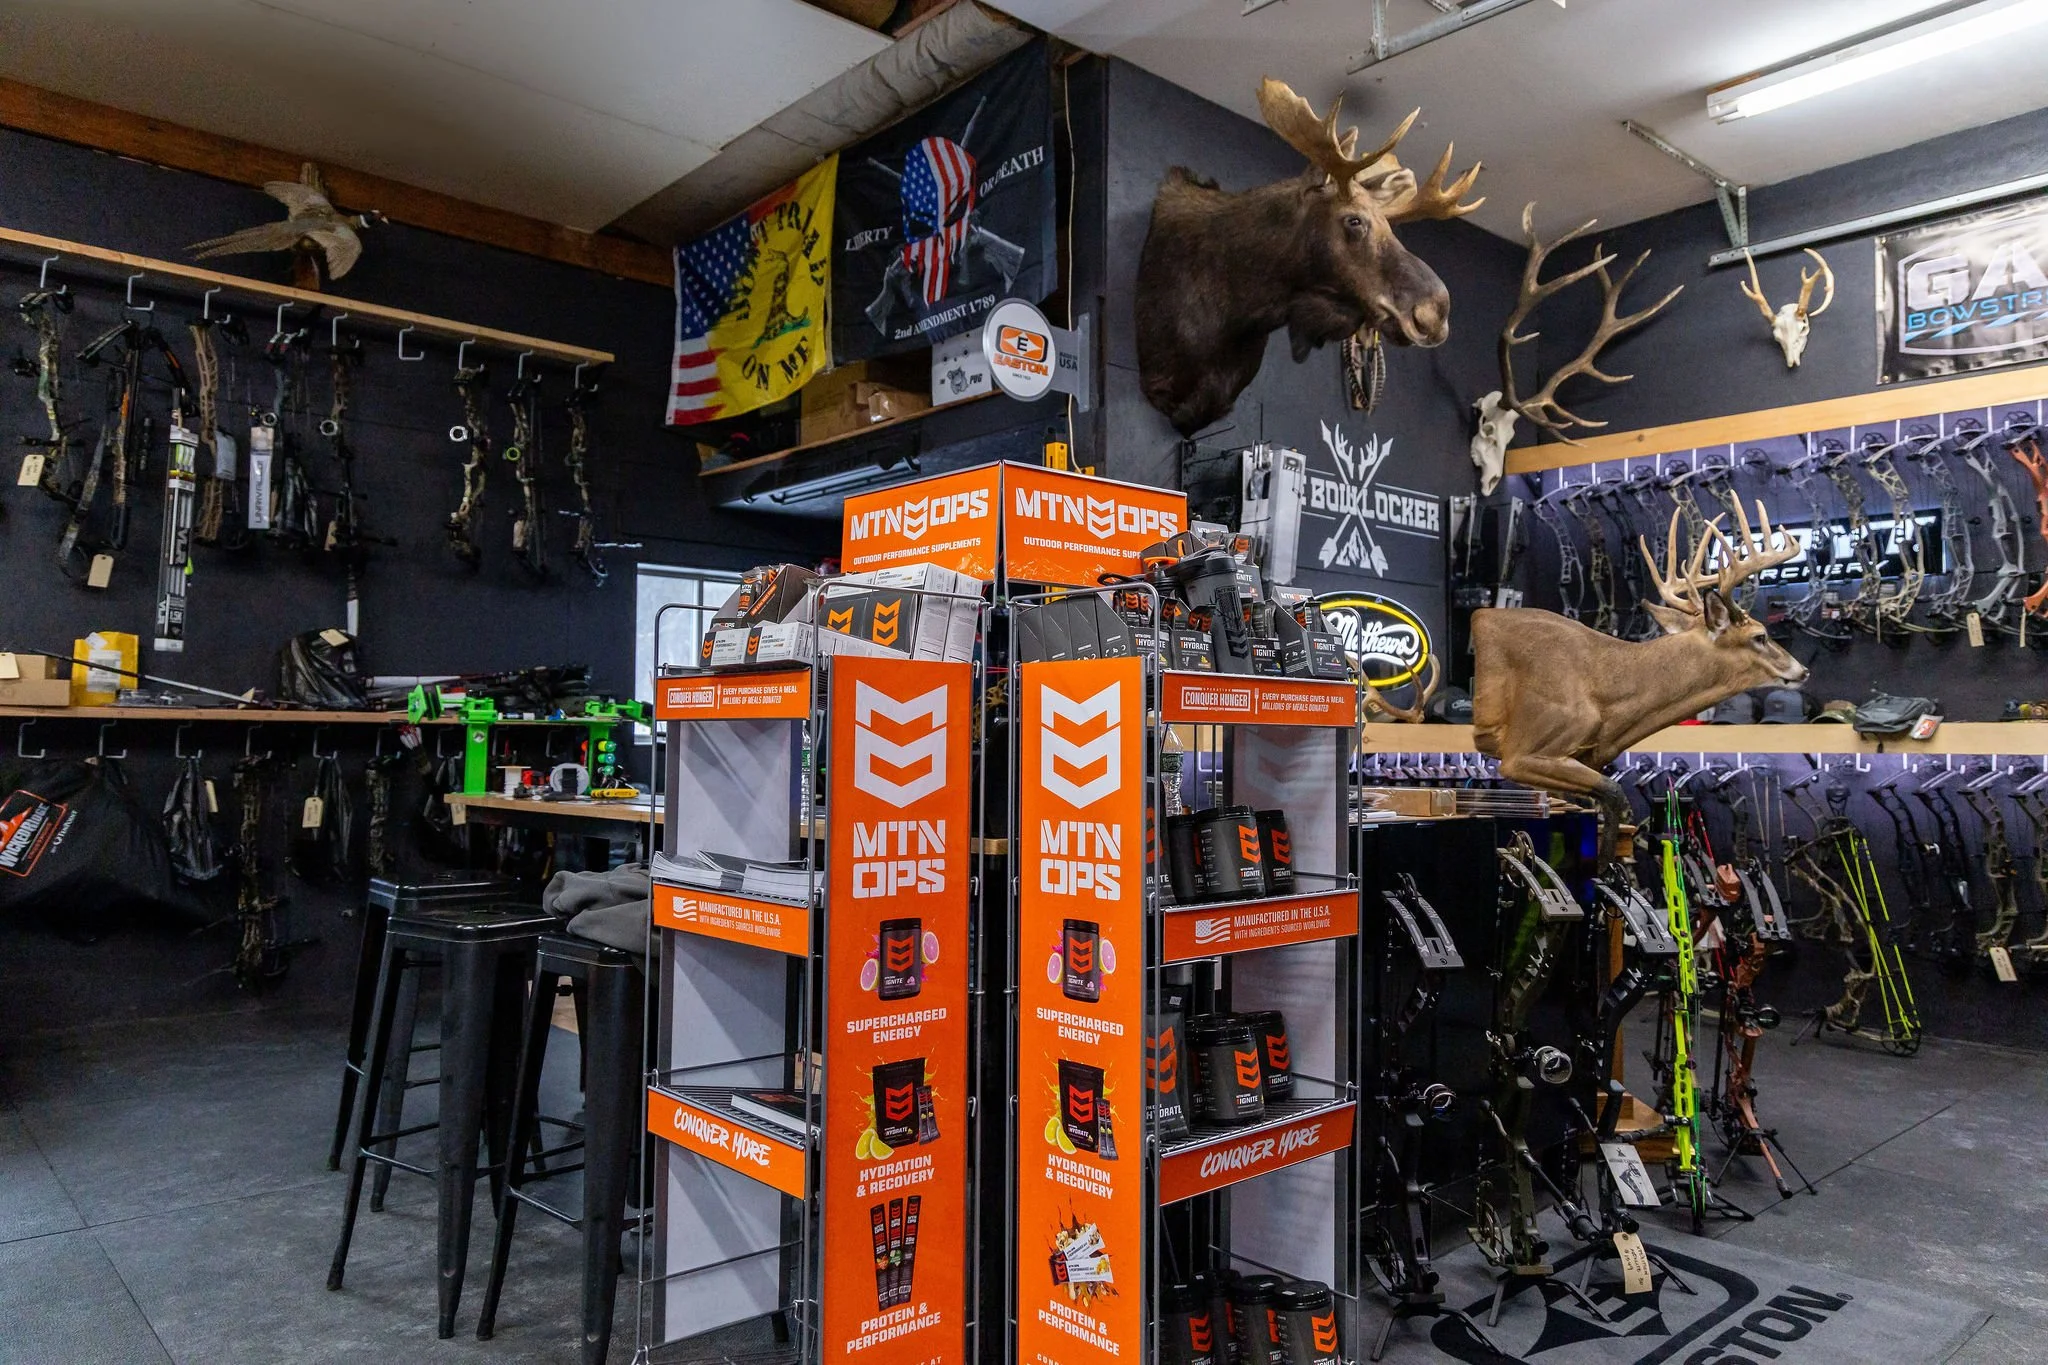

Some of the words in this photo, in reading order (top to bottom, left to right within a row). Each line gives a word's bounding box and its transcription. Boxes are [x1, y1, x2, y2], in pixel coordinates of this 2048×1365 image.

[894, 322, 913, 340] 2nd
[912, 303, 967, 337] AMENDMENT
[968, 294, 996, 316] 1789
[742, 353, 770, 391] ON
[993, 353, 1049, 376] EASTON
[1059, 359, 1078, 371] USA
[970, 373, 982, 384] PUG
[851, 506, 902, 541] MTN
[930, 488, 989, 526] OPS
[1015, 487, 1084, 526] MTN
[1118, 505, 1178, 539] OPS
[1310, 477, 1358, 516] BOW
[1361, 487, 1440, 532] LOCKER
[853, 553, 882, 566] OUTDOOR
[883, 546, 930, 561] PERFORMANCE
[930, 537, 981, 554] SUPPLEMENTS
[1023, 535, 1063, 550] OUTDOOR
[1063, 541, 1121, 558] PERFORMANCE
[1183, 641, 1209, 651] HYDRATE
[1317, 642, 1336, 652] IGNITE
[669, 692, 691, 704] CONQUER
[692, 691, 713, 704] HUNGER
[722, 696, 741, 705] MILLIONS
[748, 696, 762, 704] MEALS
[723, 687, 737, 696] EVERY
[738, 686, 763, 695] PURCHASE
[763, 686, 778, 694] GIVES
[784, 685, 797, 693] MEAL
[1185, 691, 1219, 706] CONQUER
[1219, 693, 1248, 707] HUNGER
[1262, 692, 1280, 701] EVERY
[1281, 693, 1308, 702] PURCHASE
[1309, 695, 1325, 703] GIVES
[1330, 696, 1345, 704] MEAL
[1262, 702, 1285, 711] MILLIONS
[1285, 703, 1292, 711] OF
[1292, 703, 1308, 711] MEALS
[1308, 704, 1329, 712] DONATED
[853, 820, 946, 858] MTN
[1040, 819, 1121, 860] MTN
[852, 859, 945, 899] OPS
[1040, 858, 1121, 901] OPS
[1244, 869, 1261, 877] IGNITE
[1275, 869, 1291, 877] IGNITE
[699, 900, 743, 919] MANUFACTURED
[744, 908, 750, 920] IN
[752, 909, 763, 922] THE
[1234, 910, 1289, 928] MANUFACTURED
[1291, 909, 1298, 920] IN
[1300, 907, 1312, 919] THE
[1313, 905, 1331, 917] U.S.A.
[700, 915, 710, 924] WITH
[710, 916, 735, 929] INGREDIENTS
[735, 921, 754, 933] SOURCED
[754, 925, 781, 938] WORLDWIDE
[1234, 929, 1248, 940] WITH
[1248, 925, 1280, 938] INGREDIENTS
[1280, 922, 1302, 934] SOURCED
[1303, 918, 1331, 930] WORLDWIDE
[846, 1008, 947, 1034] SUPERCHARGED
[1036, 1007, 1124, 1036] SUPERCHARGED
[873, 1025, 921, 1043] ENERGY
[1058, 1025, 1101, 1045] ENERGY
[1271, 1075, 1288, 1084] IGNITE
[1239, 1096, 1258, 1104] IGNITE
[673, 1106, 729, 1150] CONQUER
[860, 1154, 932, 1182] HYDRATION
[1048, 1153, 1111, 1185] HYDRATION
[1200, 1138, 1275, 1178] CONQUER
[856, 1184, 866, 1198] &
[869, 1168, 935, 1194] RECOVERY
[1045, 1167, 1053, 1179] &
[1056, 1171, 1114, 1200] RECOVERY
[860, 1305, 915, 1333] PROTEIN
[918, 1302, 928, 1316] &
[1050, 1300, 1096, 1332] PROTEIN
[1098, 1321, 1107, 1335] &
[846, 1311, 941, 1354] PERFORMANCE
[1038, 1309, 1120, 1356] PERFORMANCE
